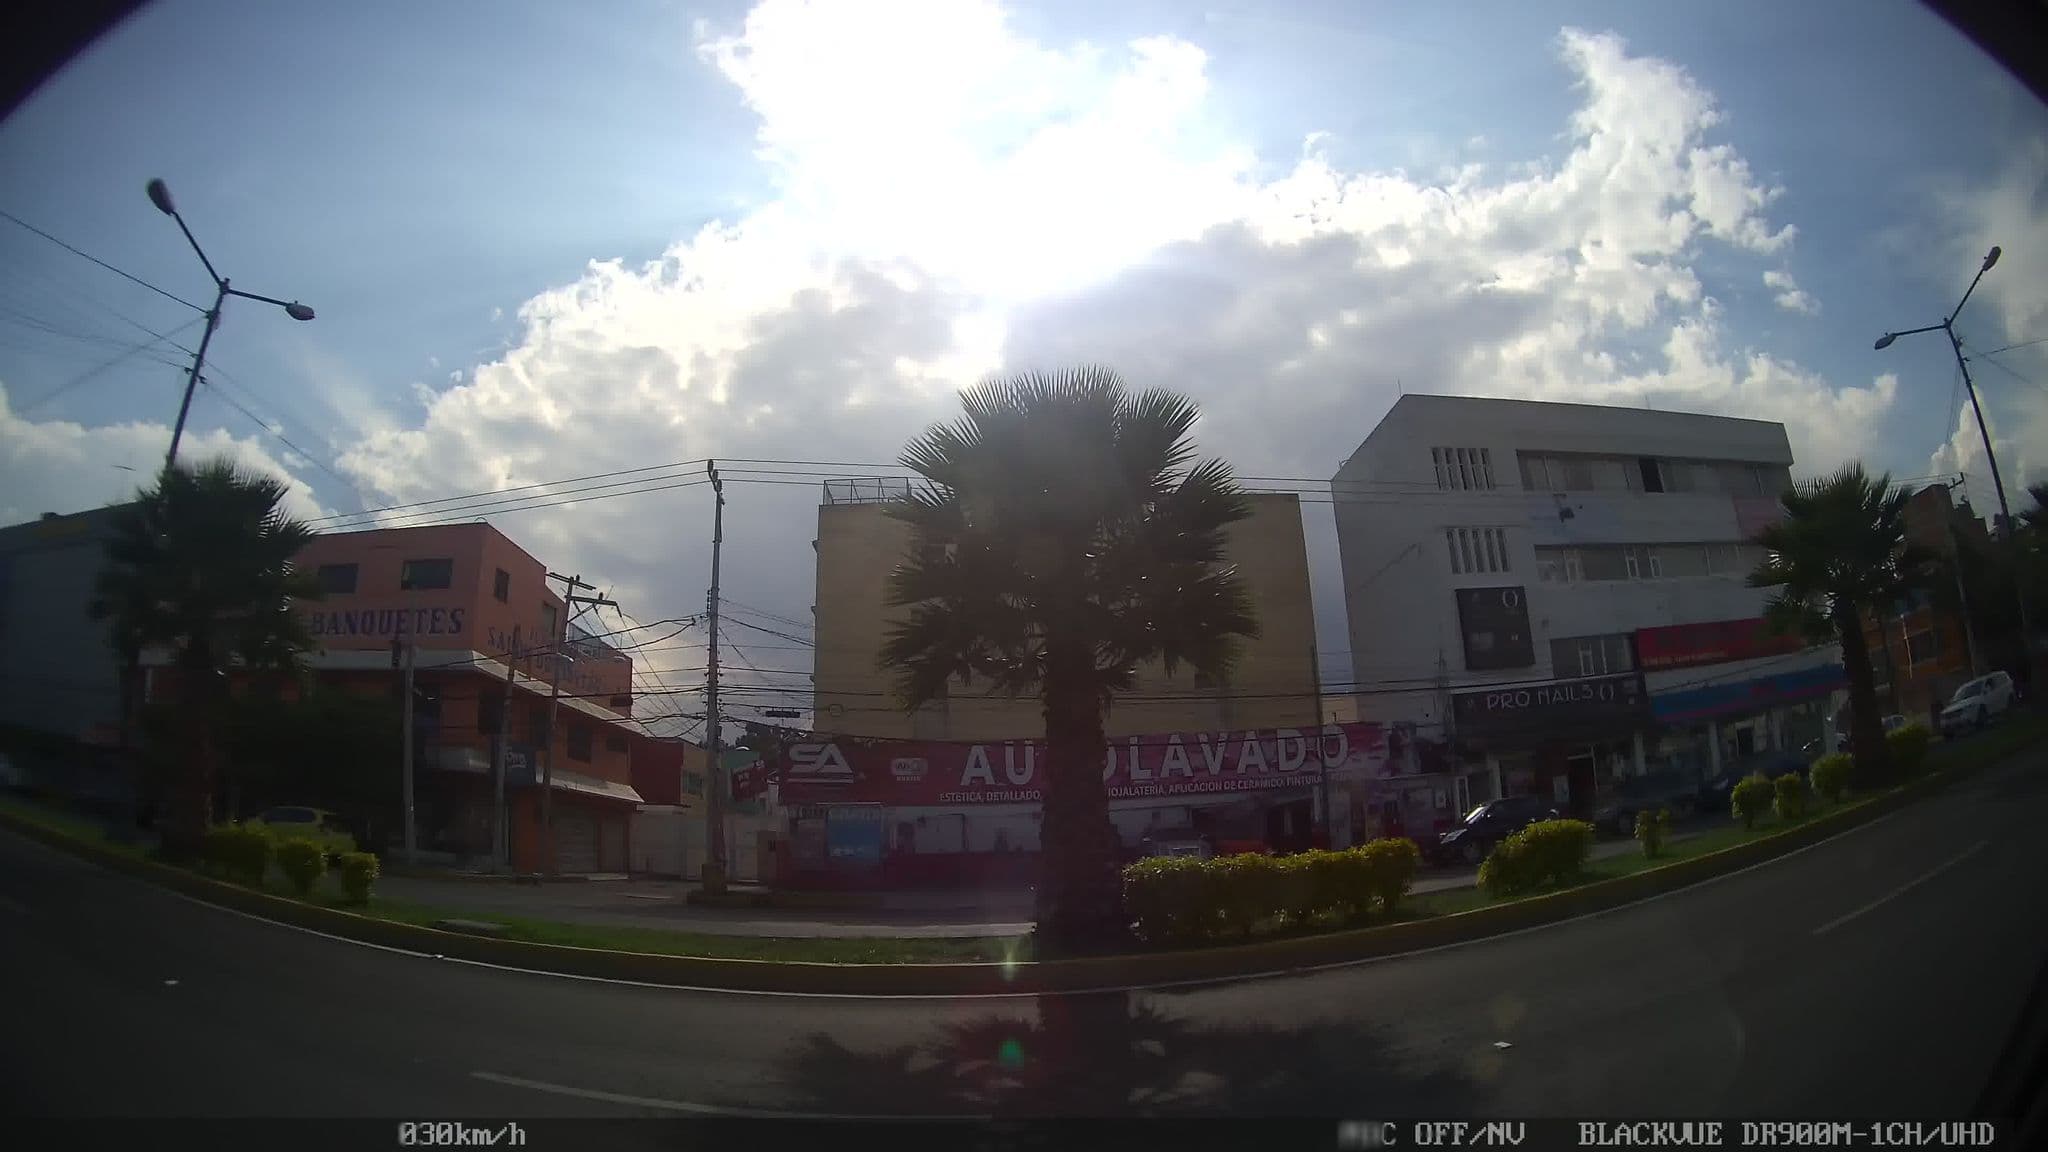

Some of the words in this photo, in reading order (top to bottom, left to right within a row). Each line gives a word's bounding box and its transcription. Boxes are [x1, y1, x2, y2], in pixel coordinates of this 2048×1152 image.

[312, 607, 465, 635] BANQUETES
[1487, 690, 1531, 709] PRO
[788, 743, 854, 774] SA
